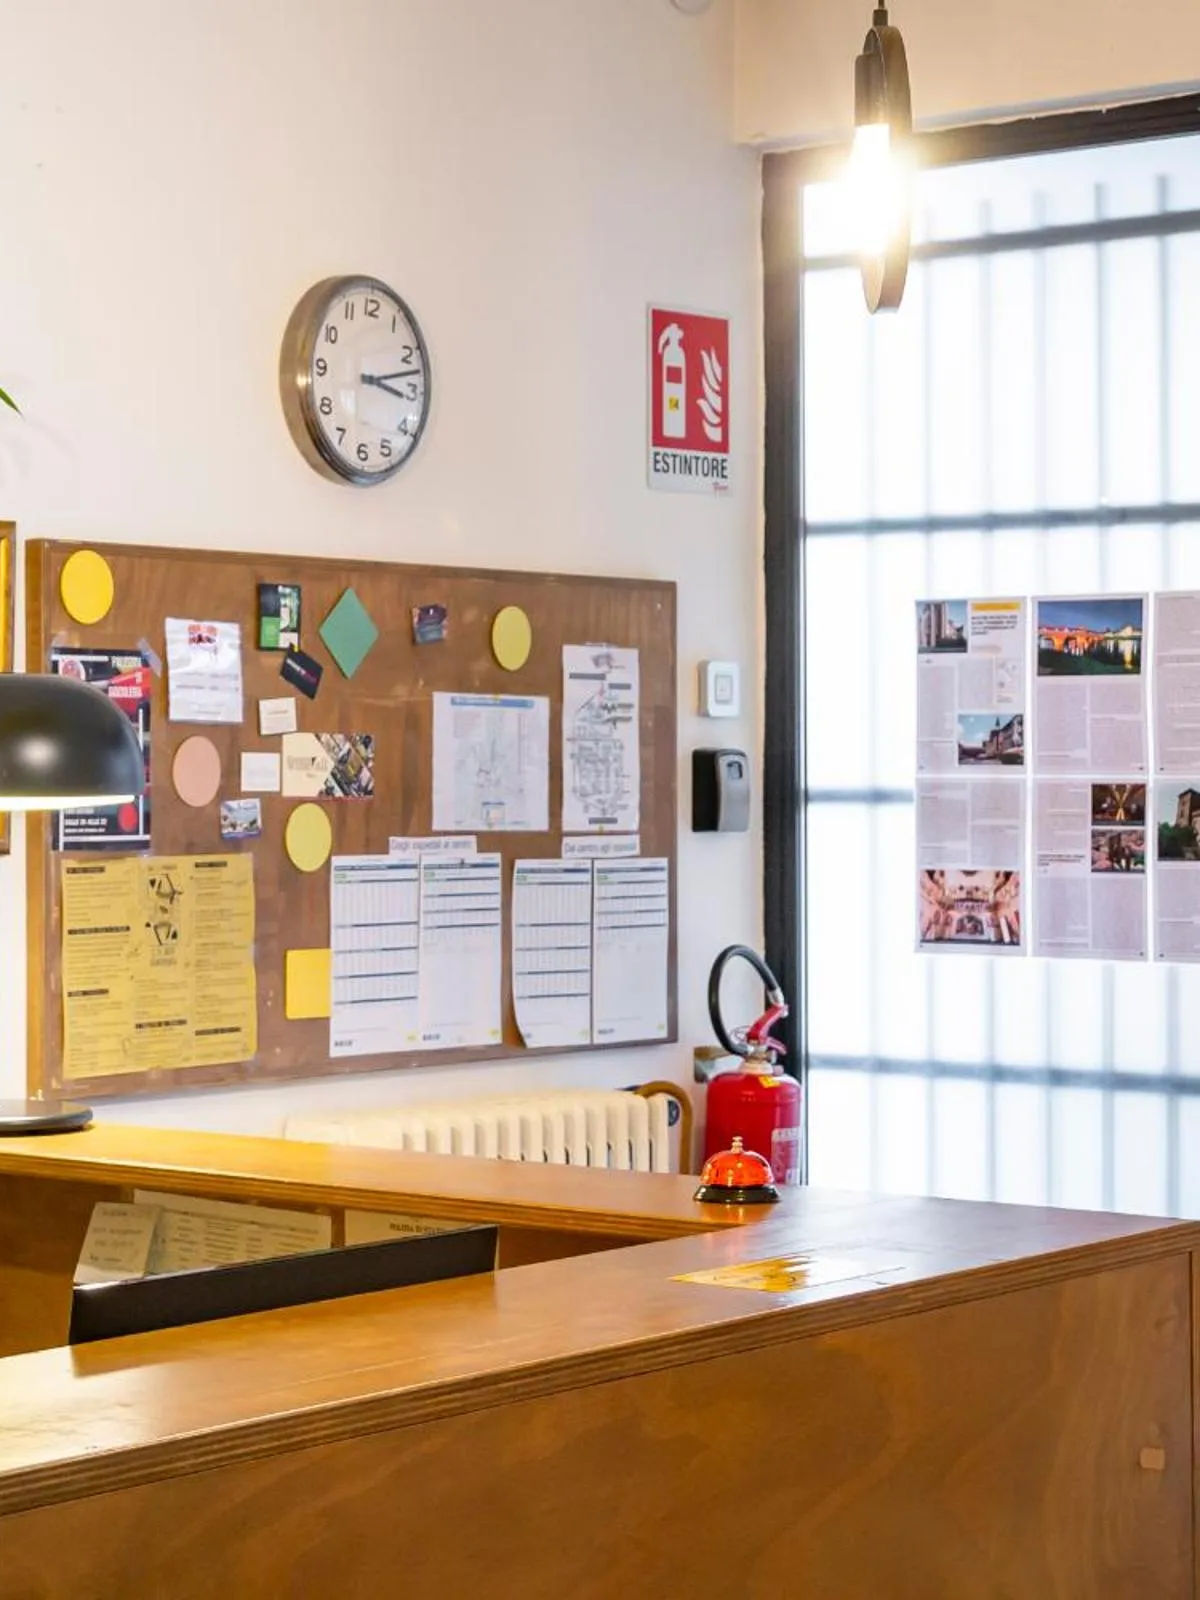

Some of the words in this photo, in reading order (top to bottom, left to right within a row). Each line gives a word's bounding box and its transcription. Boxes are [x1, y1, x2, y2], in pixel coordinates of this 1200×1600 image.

[345, 301, 354, 320] 11
[364, 298, 381, 318] 12
[392, 313, 396, 333] 1
[325, 323, 338, 344] 10
[401, 345, 413, 364] 2
[316, 358, 327, 376] 9
[405, 383, 417, 401] 3
[319, 396, 332, 415] 8
[398, 417, 408, 435] 4
[336, 427, 346, 445] 7
[357, 443, 369, 461] 6
[380, 439, 392, 457] 5
[653, 451, 728, 479] ESTINTORE
